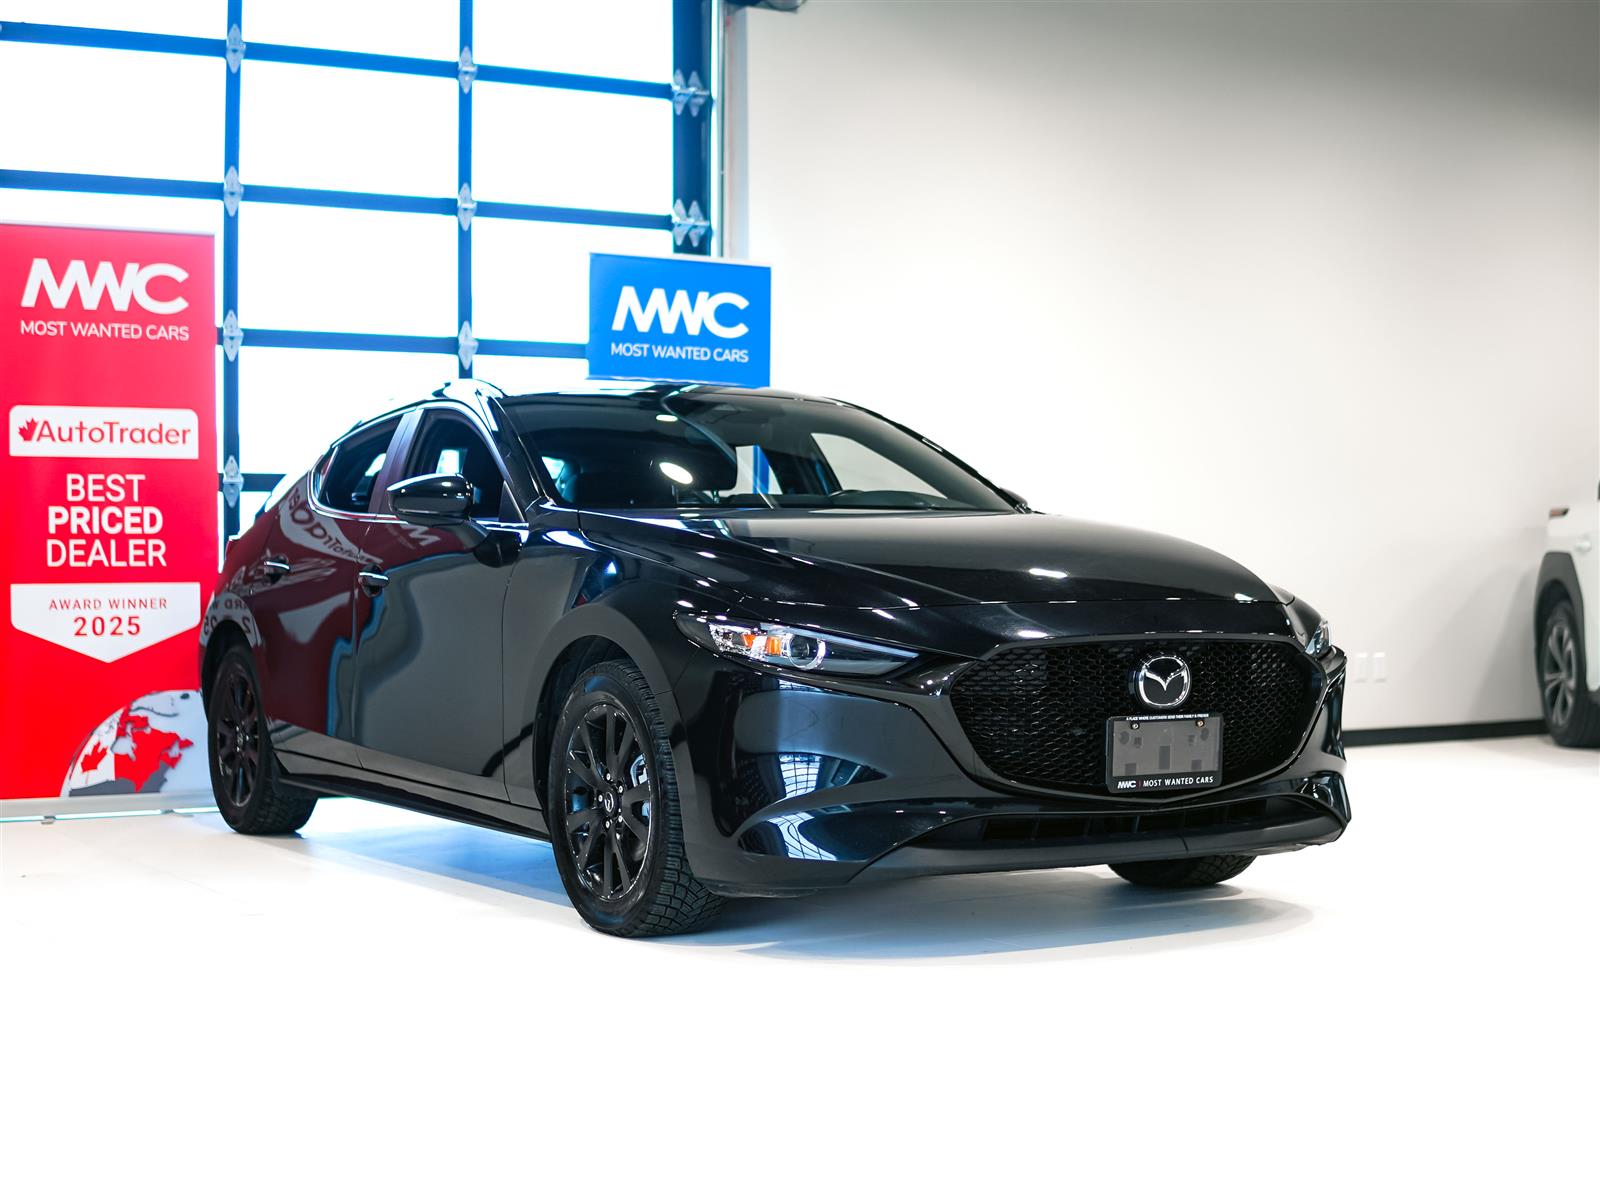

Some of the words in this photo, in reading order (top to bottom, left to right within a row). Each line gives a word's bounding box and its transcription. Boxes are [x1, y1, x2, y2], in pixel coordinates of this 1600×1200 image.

[21, 257, 190, 315] MWC
[611, 286, 750, 339] MWC
[20, 320, 67, 337] MOST
[70, 322, 142, 340] WANTED
[146, 325, 190, 341] CARS
[611, 343, 650, 357] MOST
[652, 345, 711, 361] WANTED
[713, 348, 749, 363] CARS
[37, 419, 191, 446] AutoTrader
[66, 473, 146, 503] BEST
[48, 506, 163, 535] PRICED
[46, 539, 167, 567] DEALER
[49, 599, 102, 611] AWARD
[108, 598, 168, 610] WINNER
[73, 615, 141, 637] 2025
[1117, 780, 1137, 789] MWC
[1142, 779, 1162, 788] MOST
[1164, 777, 1194, 786] WANTED
[1195, 775, 1214, 784] CARS
